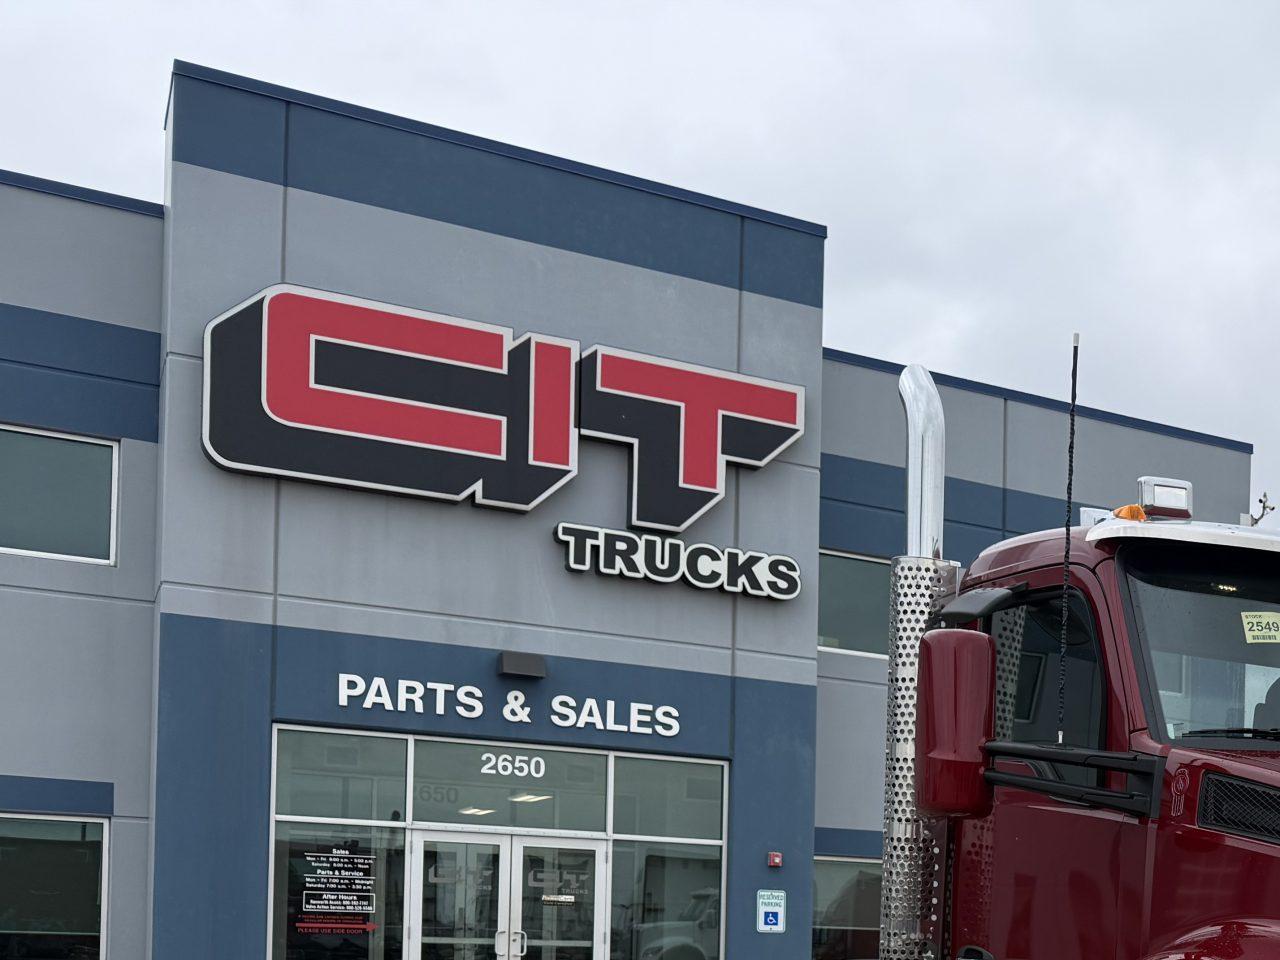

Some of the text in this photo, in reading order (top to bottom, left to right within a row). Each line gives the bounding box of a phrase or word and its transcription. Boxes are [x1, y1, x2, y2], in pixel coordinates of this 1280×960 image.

[203, 282, 805, 532] CIT
[556, 523, 801, 600] TRUCKS
[337, 673, 681, 737] PARTS & SALES
[480, 752, 546, 779] 2650
